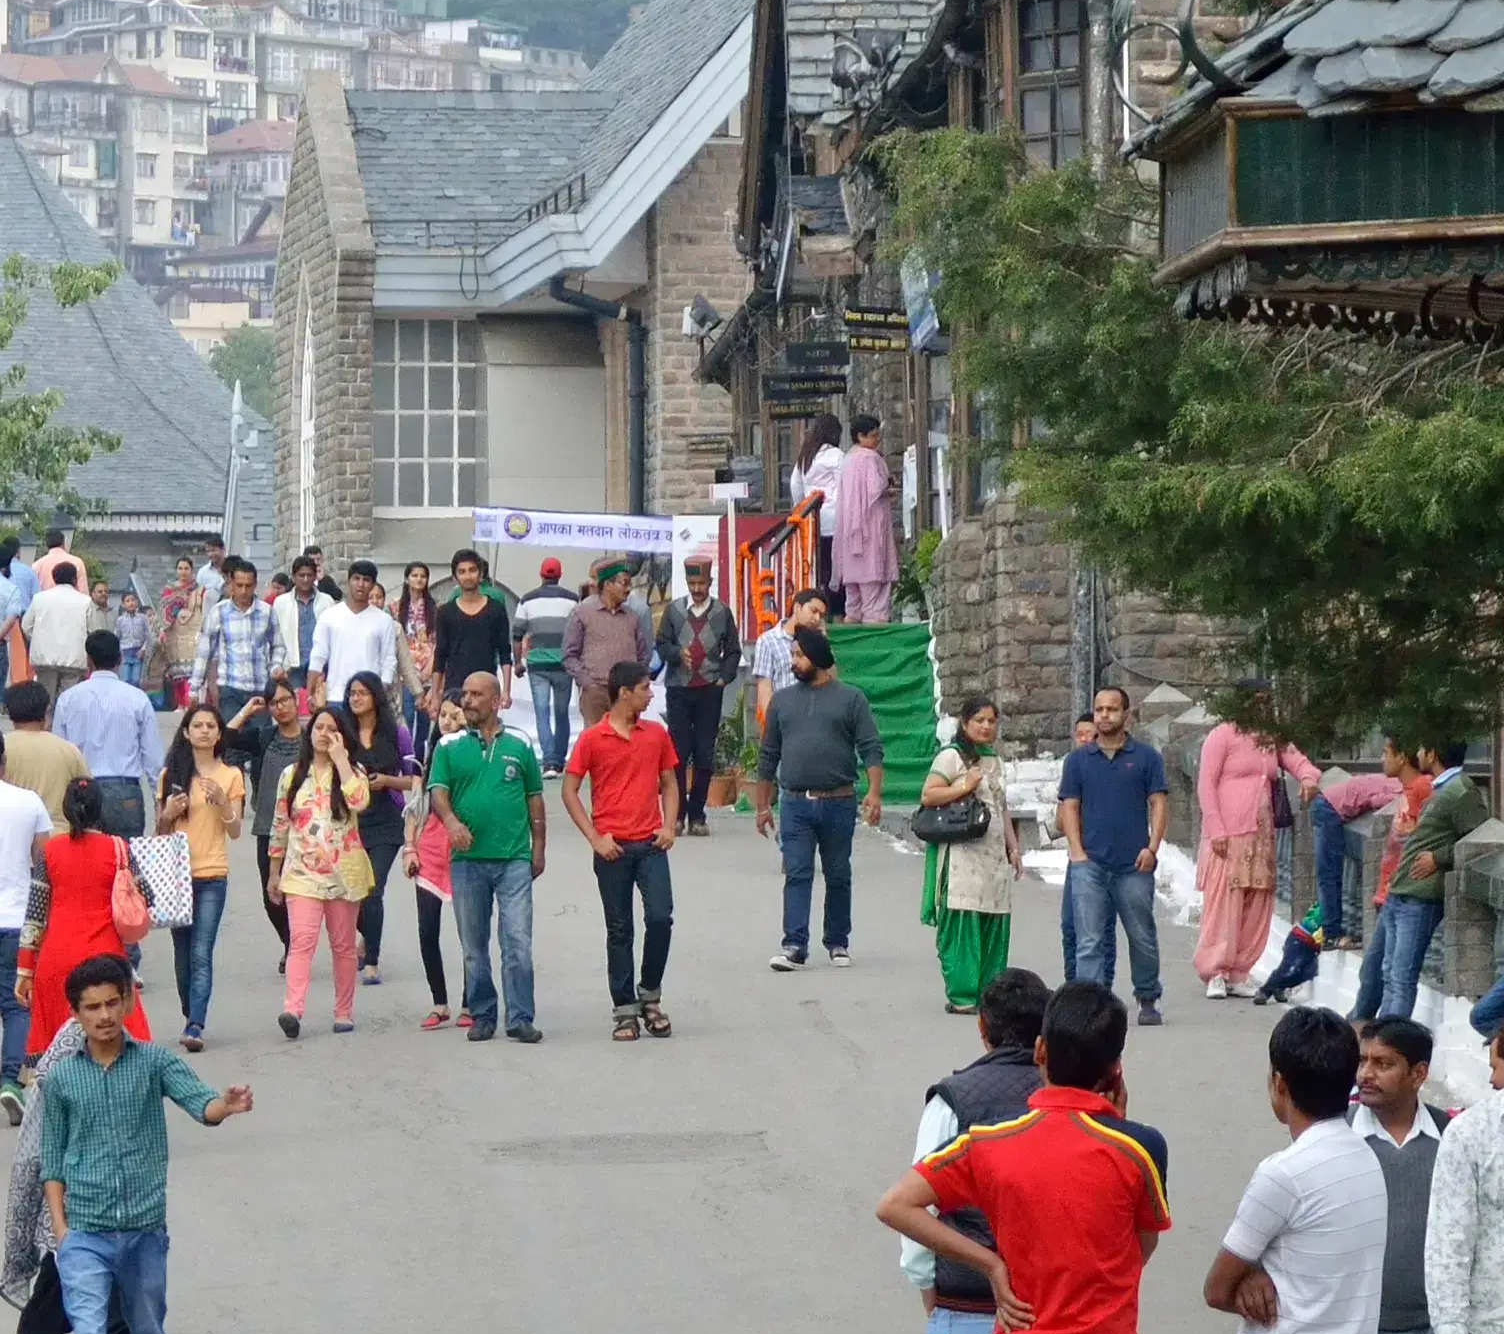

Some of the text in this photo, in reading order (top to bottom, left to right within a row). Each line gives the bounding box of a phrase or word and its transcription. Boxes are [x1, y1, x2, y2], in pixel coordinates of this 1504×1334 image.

[537, 522, 572, 535] आपका
[577, 525, 614, 538] मतदान
[618, 523, 661, 541] लोकतंत्र
